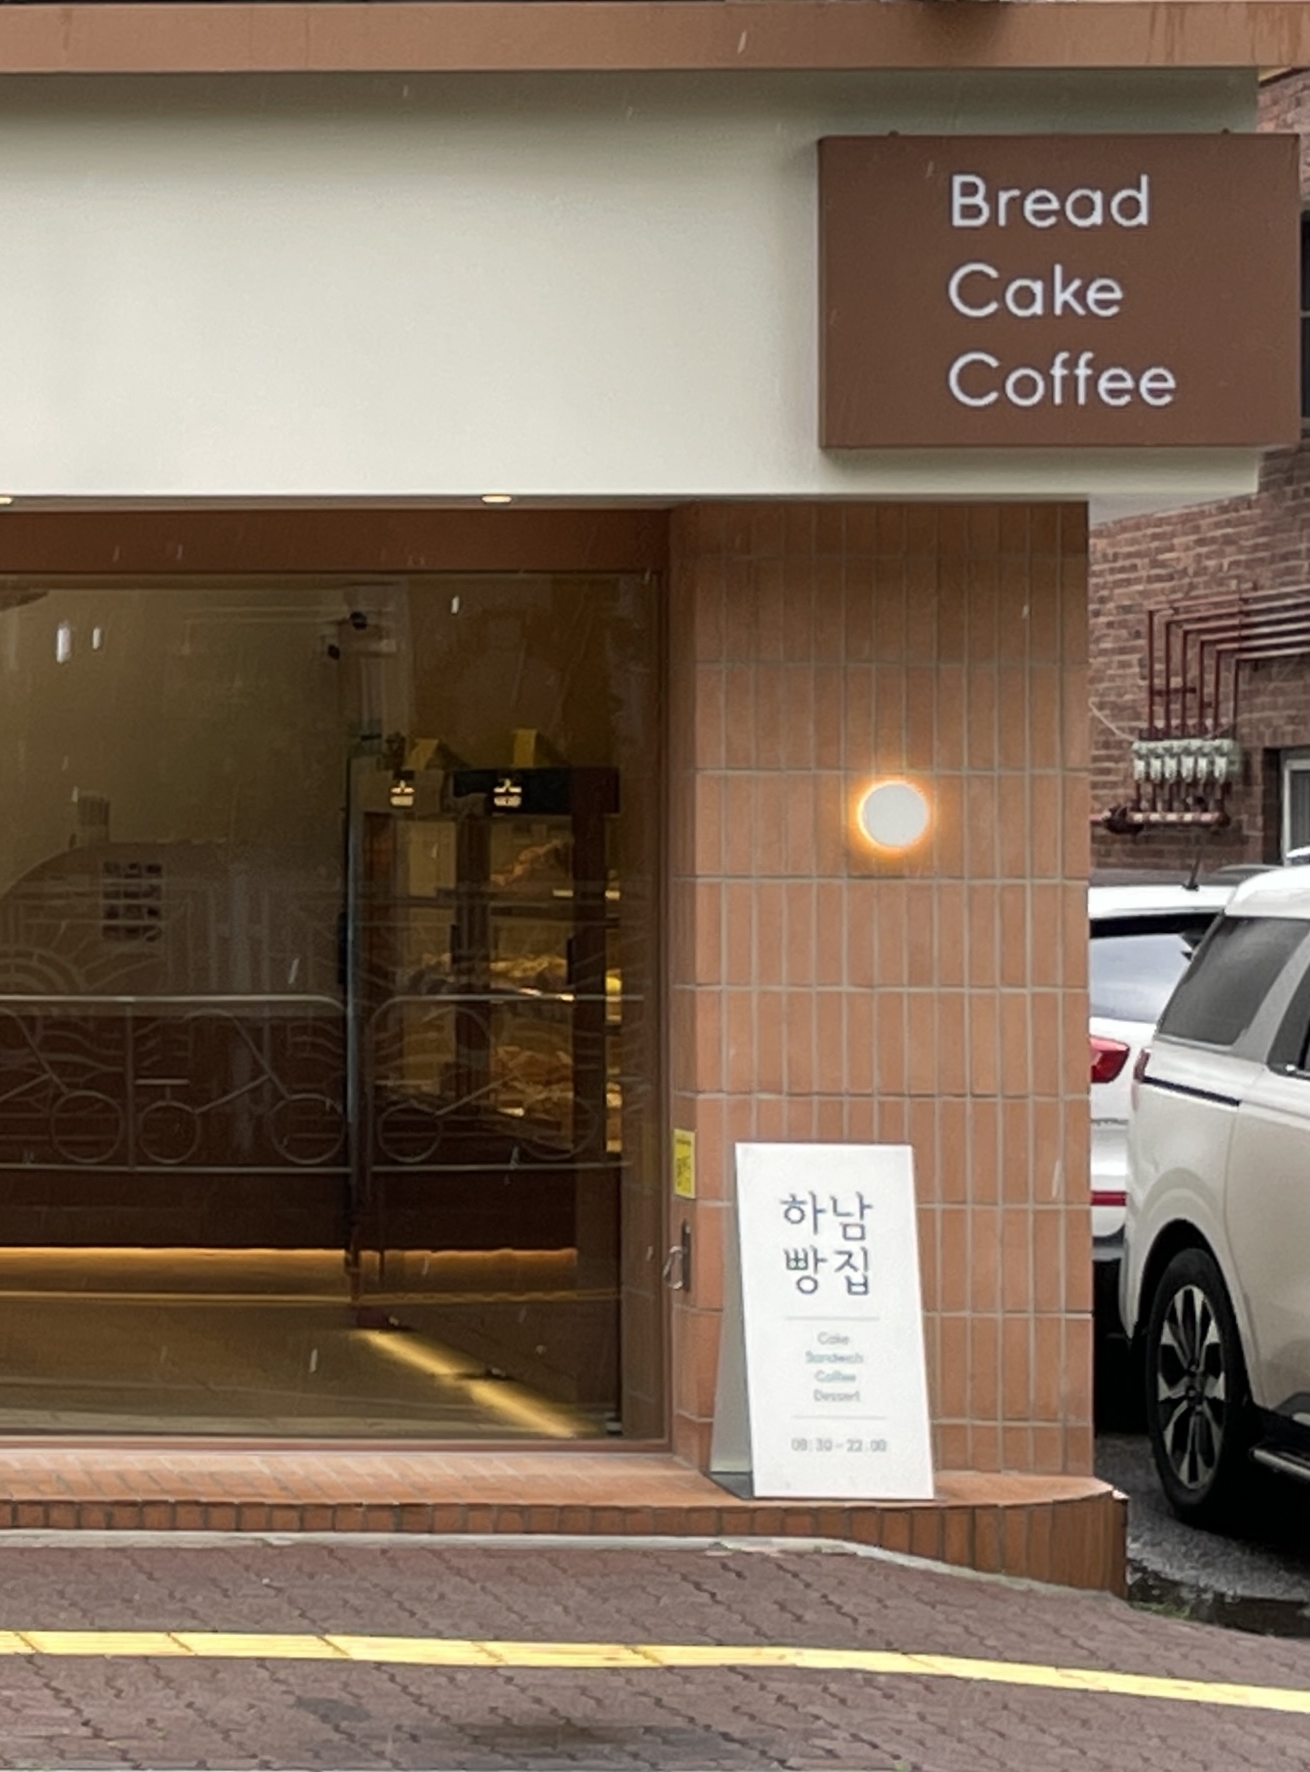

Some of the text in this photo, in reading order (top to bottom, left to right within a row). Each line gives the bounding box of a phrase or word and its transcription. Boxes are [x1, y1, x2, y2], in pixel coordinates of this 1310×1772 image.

[949, 173, 1151, 228] Bread
[948, 262, 1124, 319] Cake
[948, 350, 1177, 407] Coffee
[780, 1189, 873, 1242] 하남
[783, 1244, 870, 1296] 빵집
[817, 1331, 850, 1345] Cake
[813, 1388, 861, 1402] Dessert
[814, 1370, 857, 1383] Coffee
